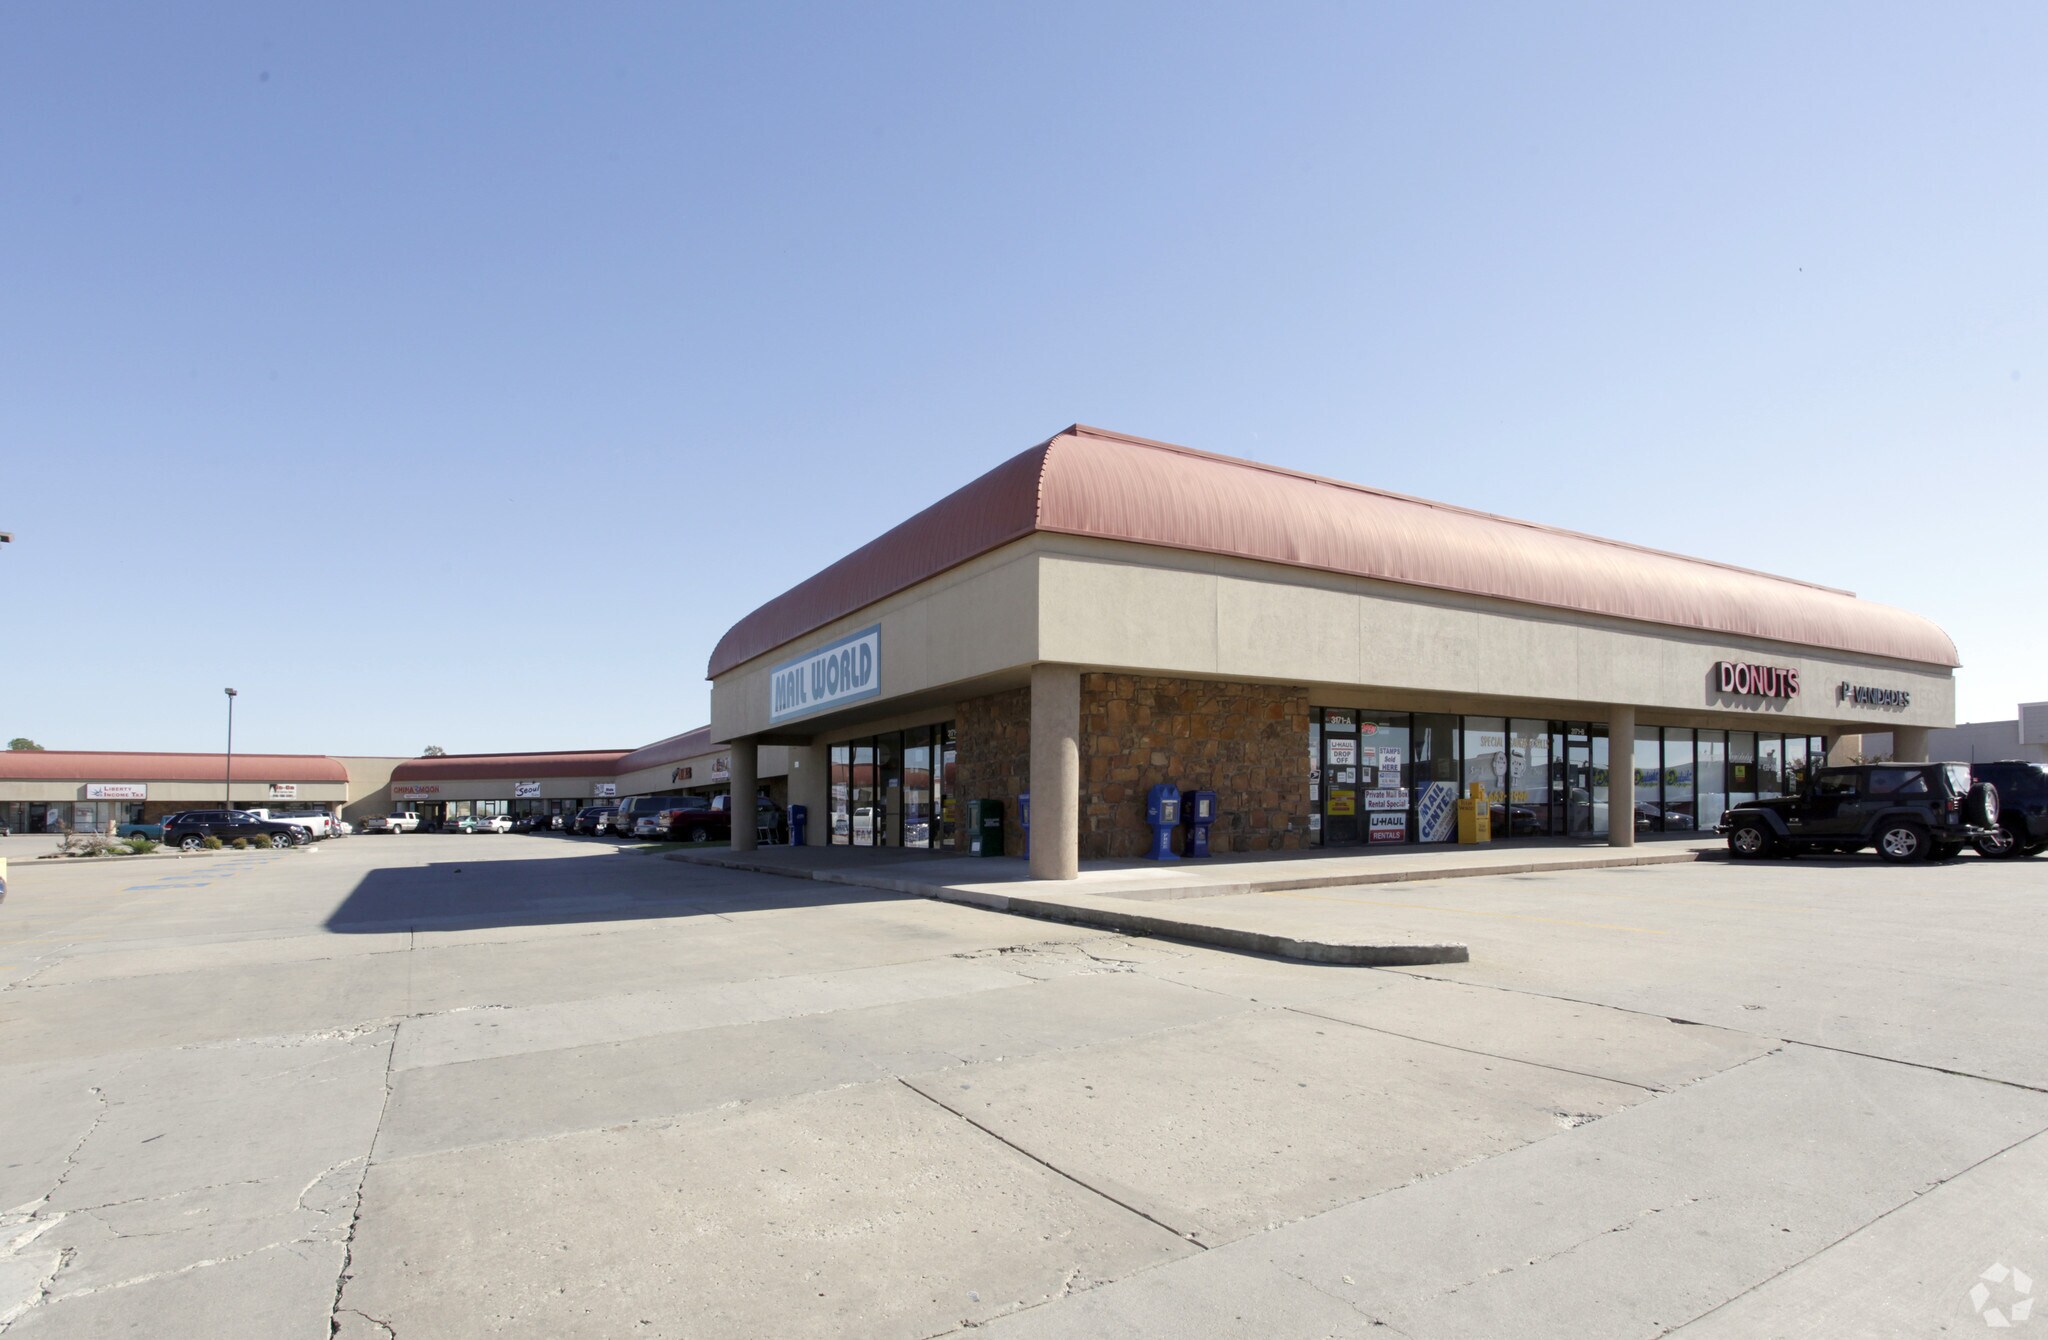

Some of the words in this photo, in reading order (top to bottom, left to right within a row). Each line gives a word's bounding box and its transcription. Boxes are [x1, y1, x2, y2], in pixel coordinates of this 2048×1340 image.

[775, 667, 807, 713] MAIL
[811, 643, 872, 700] WORLD
[1718, 661, 1800, 699] DONUTS
[1480, 736, 1503, 747] SPECIAL
[516, 787, 540, 797] Seoul
[1386, 790, 1397, 798] Mail
[1386, 800, 1406, 808] Special
[1420, 783, 1444, 819] MAIL
[1371, 817, 1404, 826] U-HAUL
